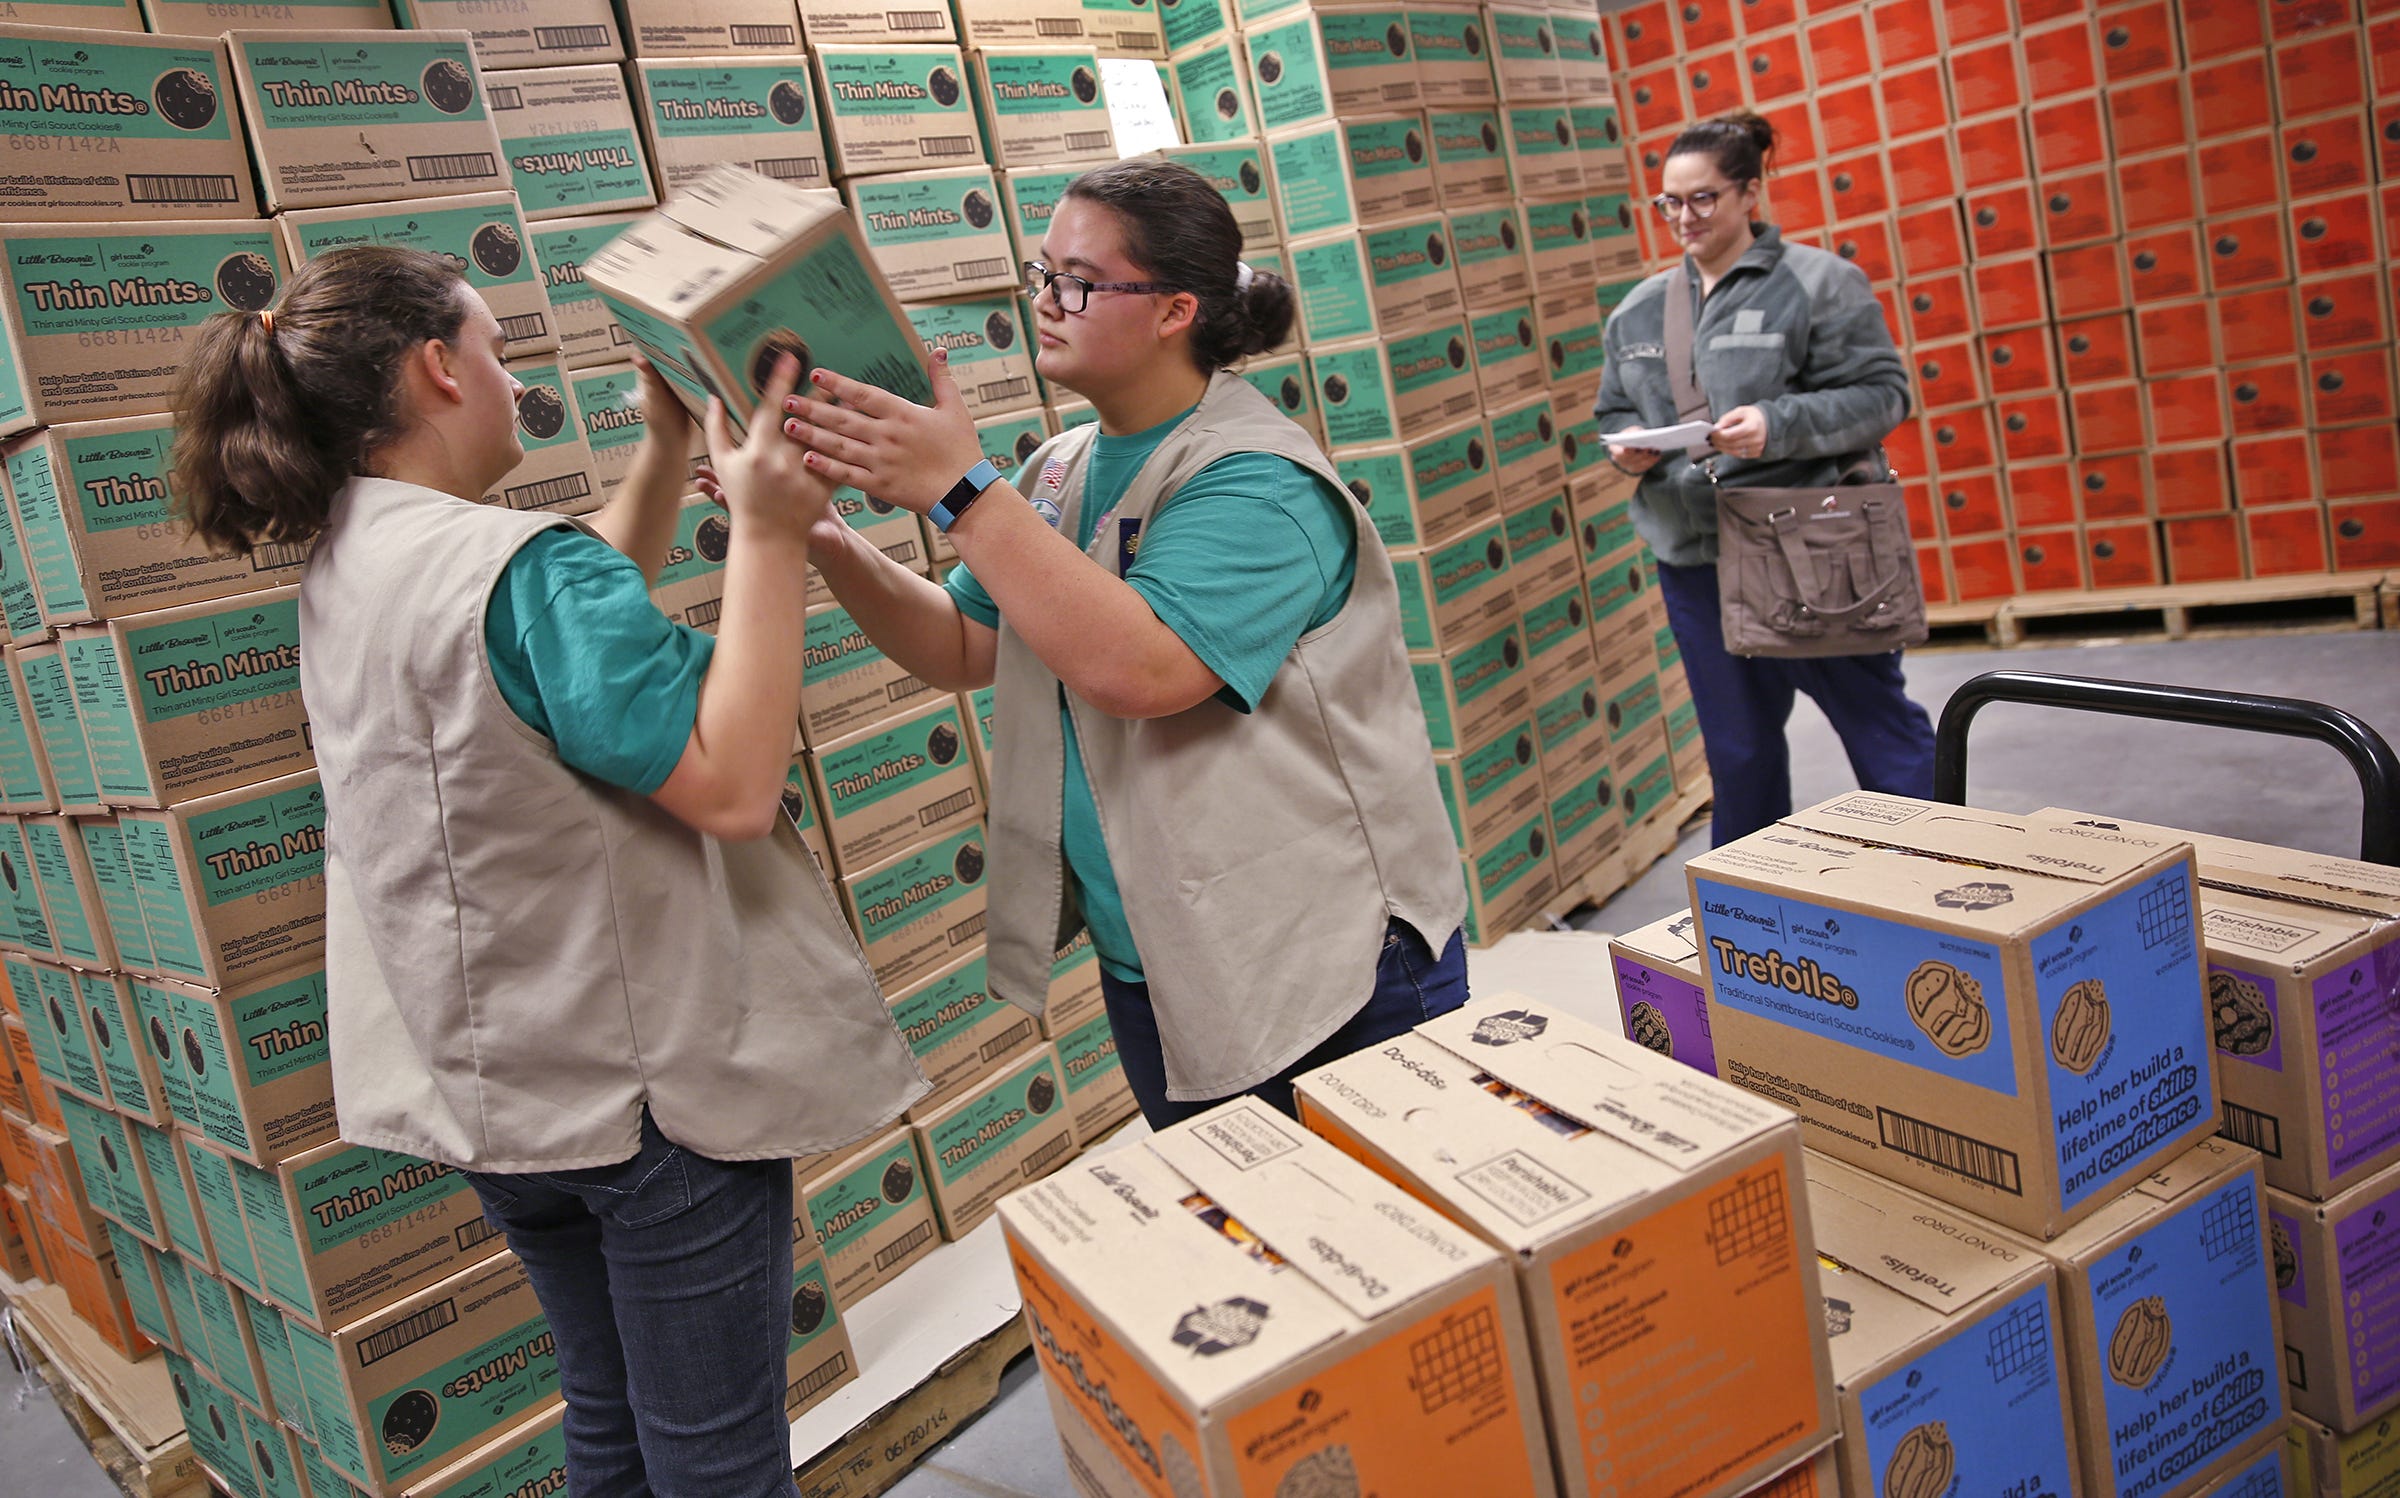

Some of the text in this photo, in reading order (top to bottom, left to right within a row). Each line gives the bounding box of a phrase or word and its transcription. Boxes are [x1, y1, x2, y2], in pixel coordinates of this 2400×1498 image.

[207, 4, 293, 19] 6687142A
[255, 57, 318, 66] Little Brownie
[262, 81, 333, 107] Thin
[833, 82, 875, 102] Thin
[658, 99, 706, 120] Thin
[9, 134, 120, 152] 6687142A
[586, 147, 634, 167] Thin
[868, 212, 908, 232] Thin
[1021, 203, 1052, 221] Thin
[18, 255, 93, 265] Little Brownie
[25, 279, 108, 311] Thin
[32, 320, 53, 329] Thin
[54, 319, 73, 327] and
[101, 316, 116, 325] Girl
[117, 315, 144, 323] Scout
[79, 327, 183, 347] 6687142A
[39, 376, 62, 386] Help
[64, 374, 80, 384] her
[82, 372, 106, 382] build
[115, 369, 150, 379] lifetime
[152, 369, 162, 377] of
[42, 384, 118, 395] and confidence.
[78, 448, 152, 464] Little Brownie
[85, 473, 165, 507] Thin
[104, 593, 121, 602] Find
[123, 589, 139, 599] your
[141, 587, 166, 596] cookies
[139, 633, 208, 654] Little Brownie
[145, 663, 221, 697] Thin
[199, 692, 296, 725] 6687142A
[160, 729, 296, 769] Help her build a lifetime of skills
[163, 758, 233, 779] and confidence.
[831, 774, 872, 801] Thin
[1763, 835, 1856, 858] Little Brownie
[2048, 826, 2161, 849] DO NOT DROP
[205, 843, 279, 880] Thin
[864, 898, 903, 926] Thin
[1705, 901, 1776, 928] Little Brownie
[2211, 914, 2300, 938] Perishable
[1718, 983, 1763, 1004] Traditional
[1764, 996, 1815, 1022] Shortbread
[1816, 1014, 1834, 1028] Girl
[1834, 1016, 1864, 1036] Scout
[249, 1021, 324, 1060] Thin
[1065, 1052, 1099, 1077] Thin
[1728, 1060, 1873, 1120] Help her build a lifetime of skills
[1731, 1075, 1800, 1107] and confidence.
[2058, 1046, 2184, 1134] Help her build a
[2061, 1065, 2198, 1164] lifetime of skills
[940, 1138, 979, 1169] Thin
[2065, 1095, 2202, 1194] and confidence.
[311, 1189, 381, 1228] Thin
[359, 1202, 450, 1249] 6687142A
[1912, 1214, 2019, 1263] DO NOT DROP
[2115, 1351, 2250, 1448] Help her build a
[885, 1408, 948, 1462] 06/20/14
[2118, 1369, 2264, 1476] lifetime of skills
[2159, 1397, 2270, 1482] confidence.
